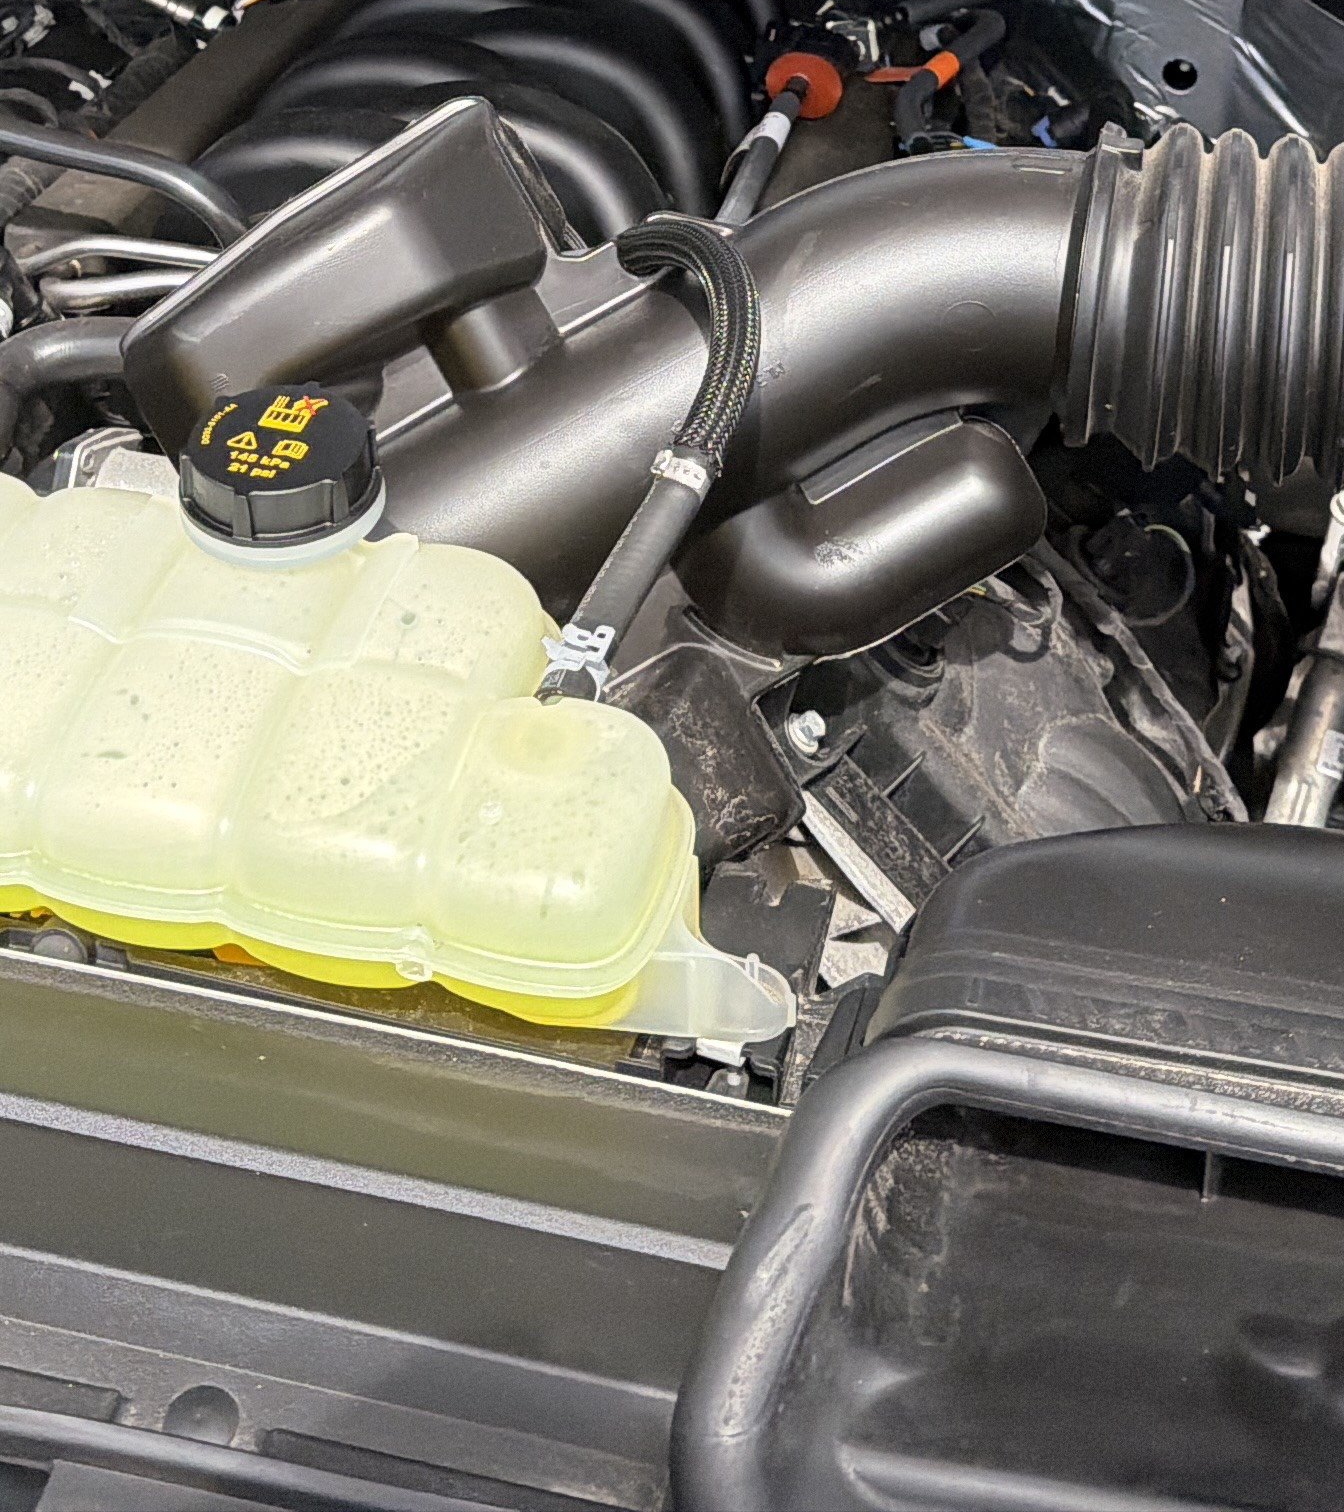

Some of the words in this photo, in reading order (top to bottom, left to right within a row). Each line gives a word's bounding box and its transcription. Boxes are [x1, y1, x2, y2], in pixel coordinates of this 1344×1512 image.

[227, 462, 249, 474] 21
[249, 468, 277, 479] psi
[260, 456, 291, 470] kPa
